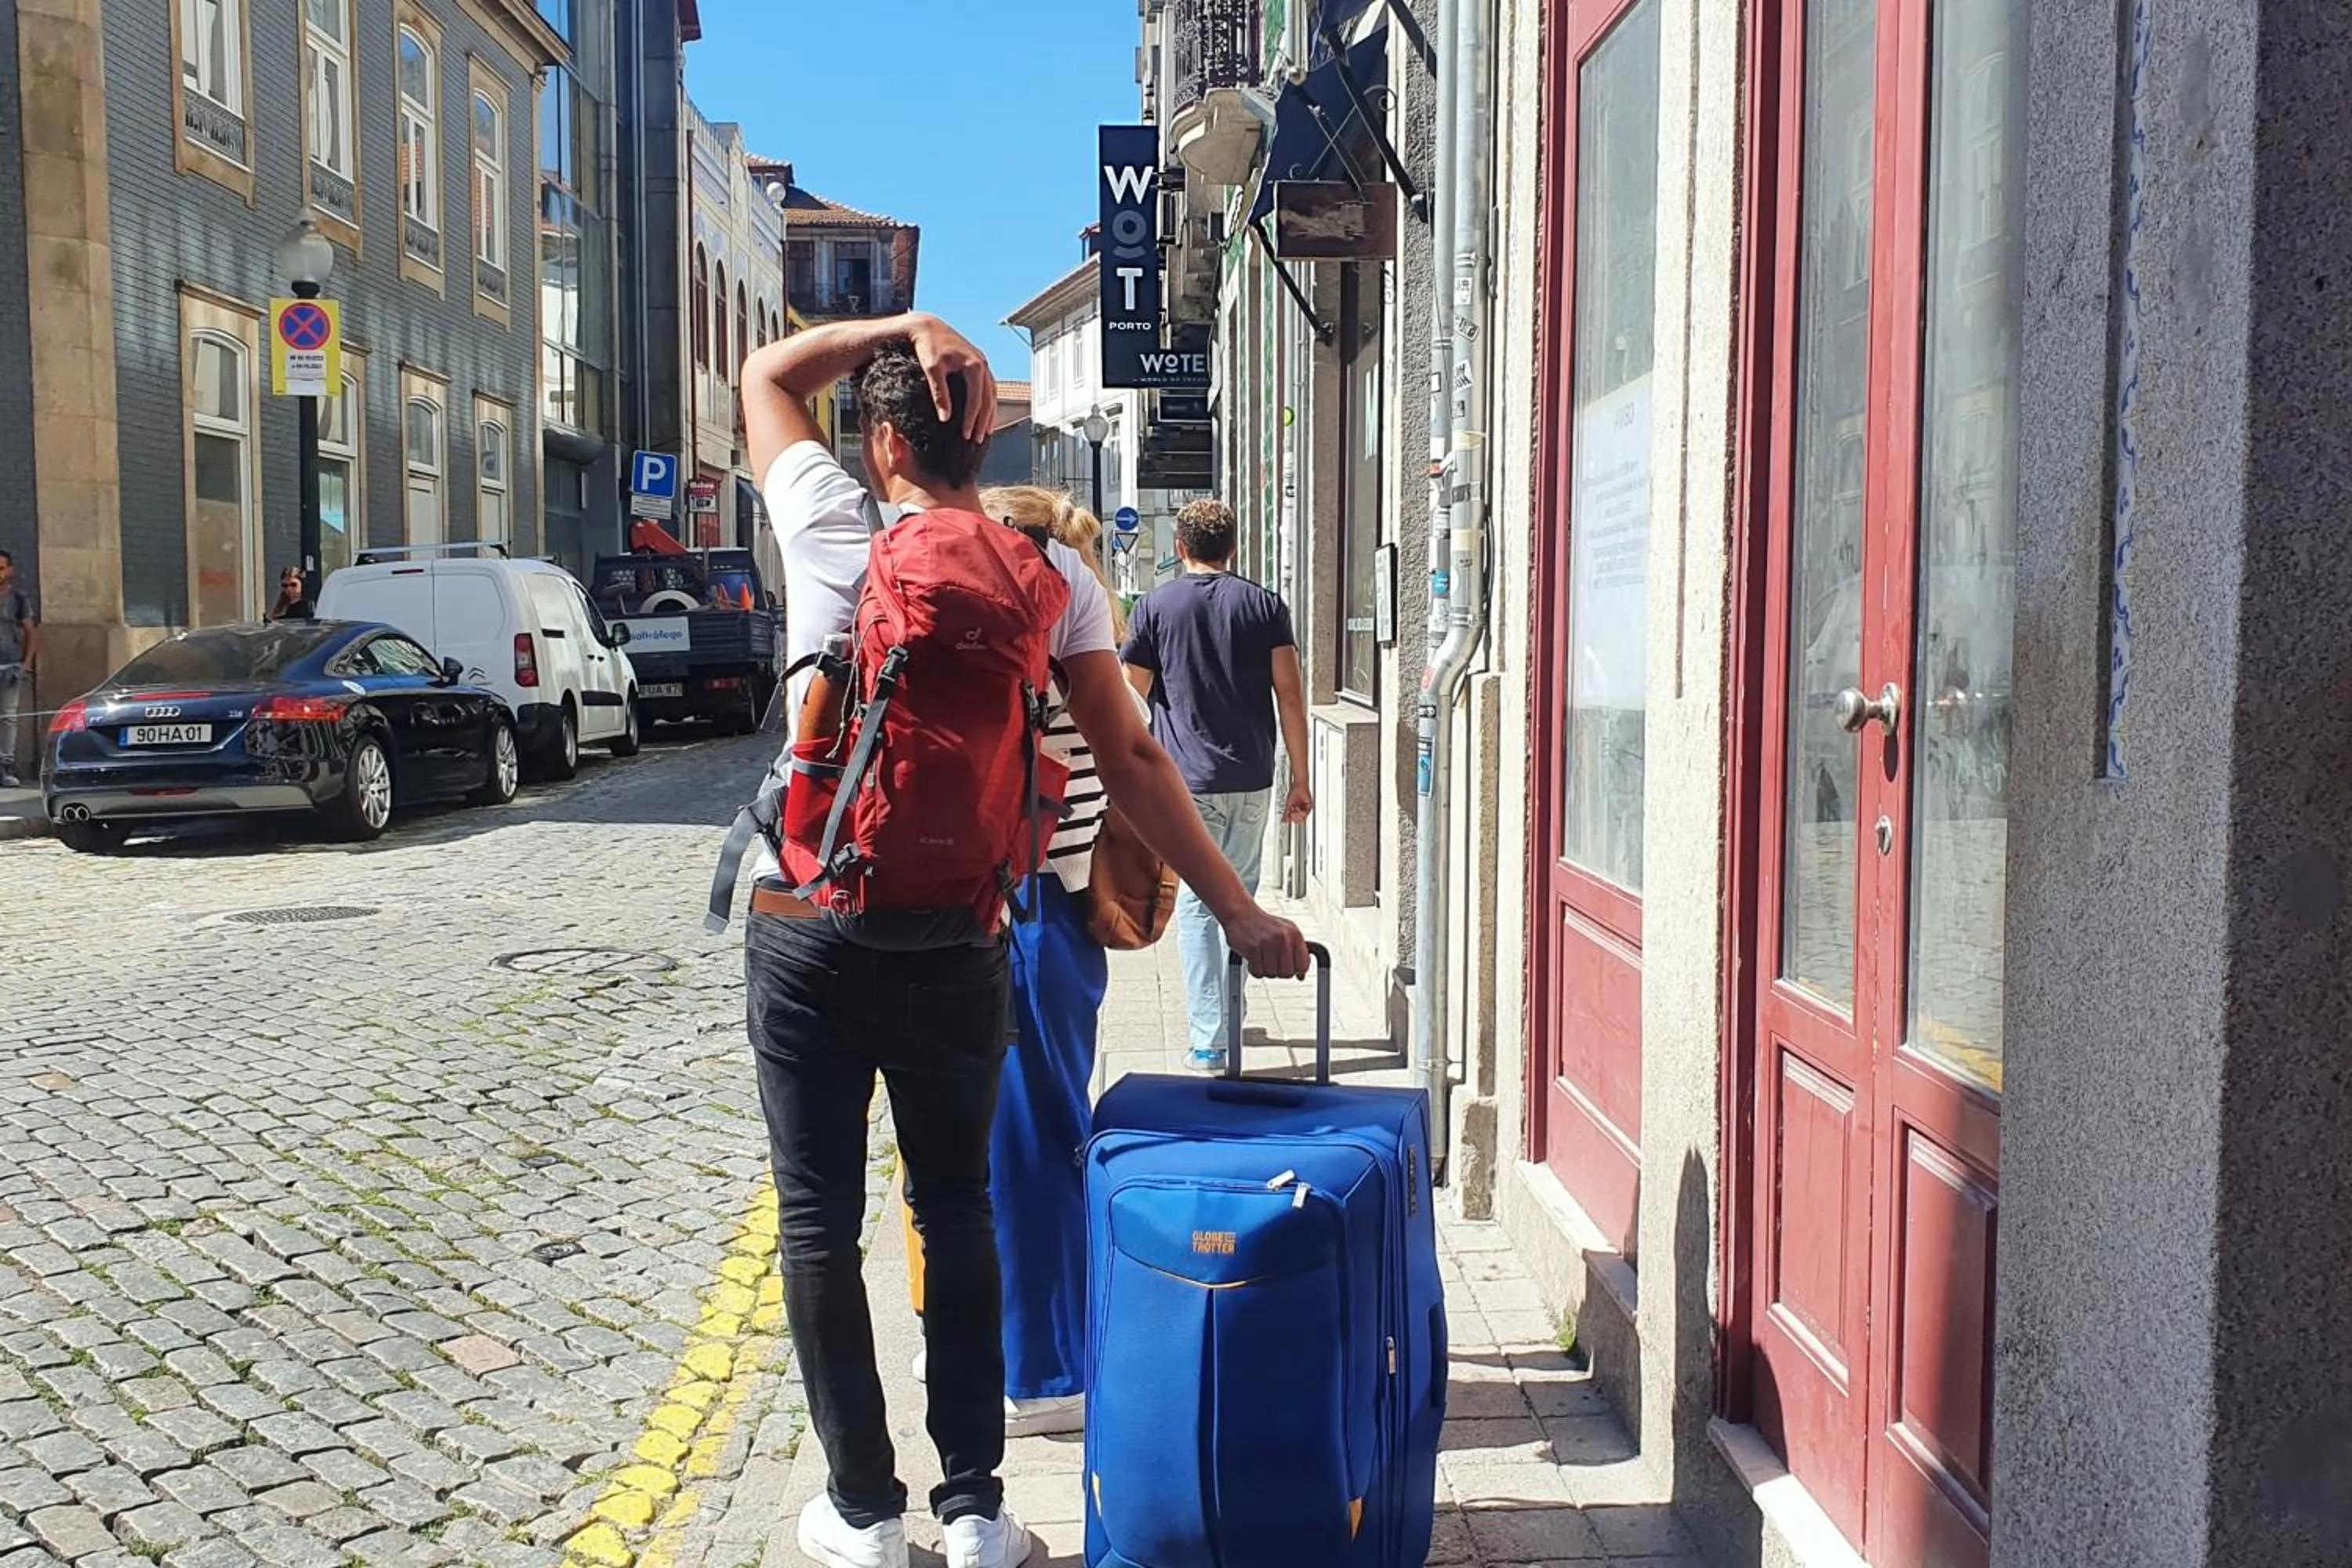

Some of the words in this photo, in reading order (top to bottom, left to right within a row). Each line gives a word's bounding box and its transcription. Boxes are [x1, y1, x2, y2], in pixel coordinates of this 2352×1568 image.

[1103, 165, 1154, 310] WOT
[1108, 321, 1152, 331] PORTO
[1139, 354, 1207, 373] WOTE
[641, 456, 666, 491] P
[1192, 1242, 1236, 1254] TROTTER
